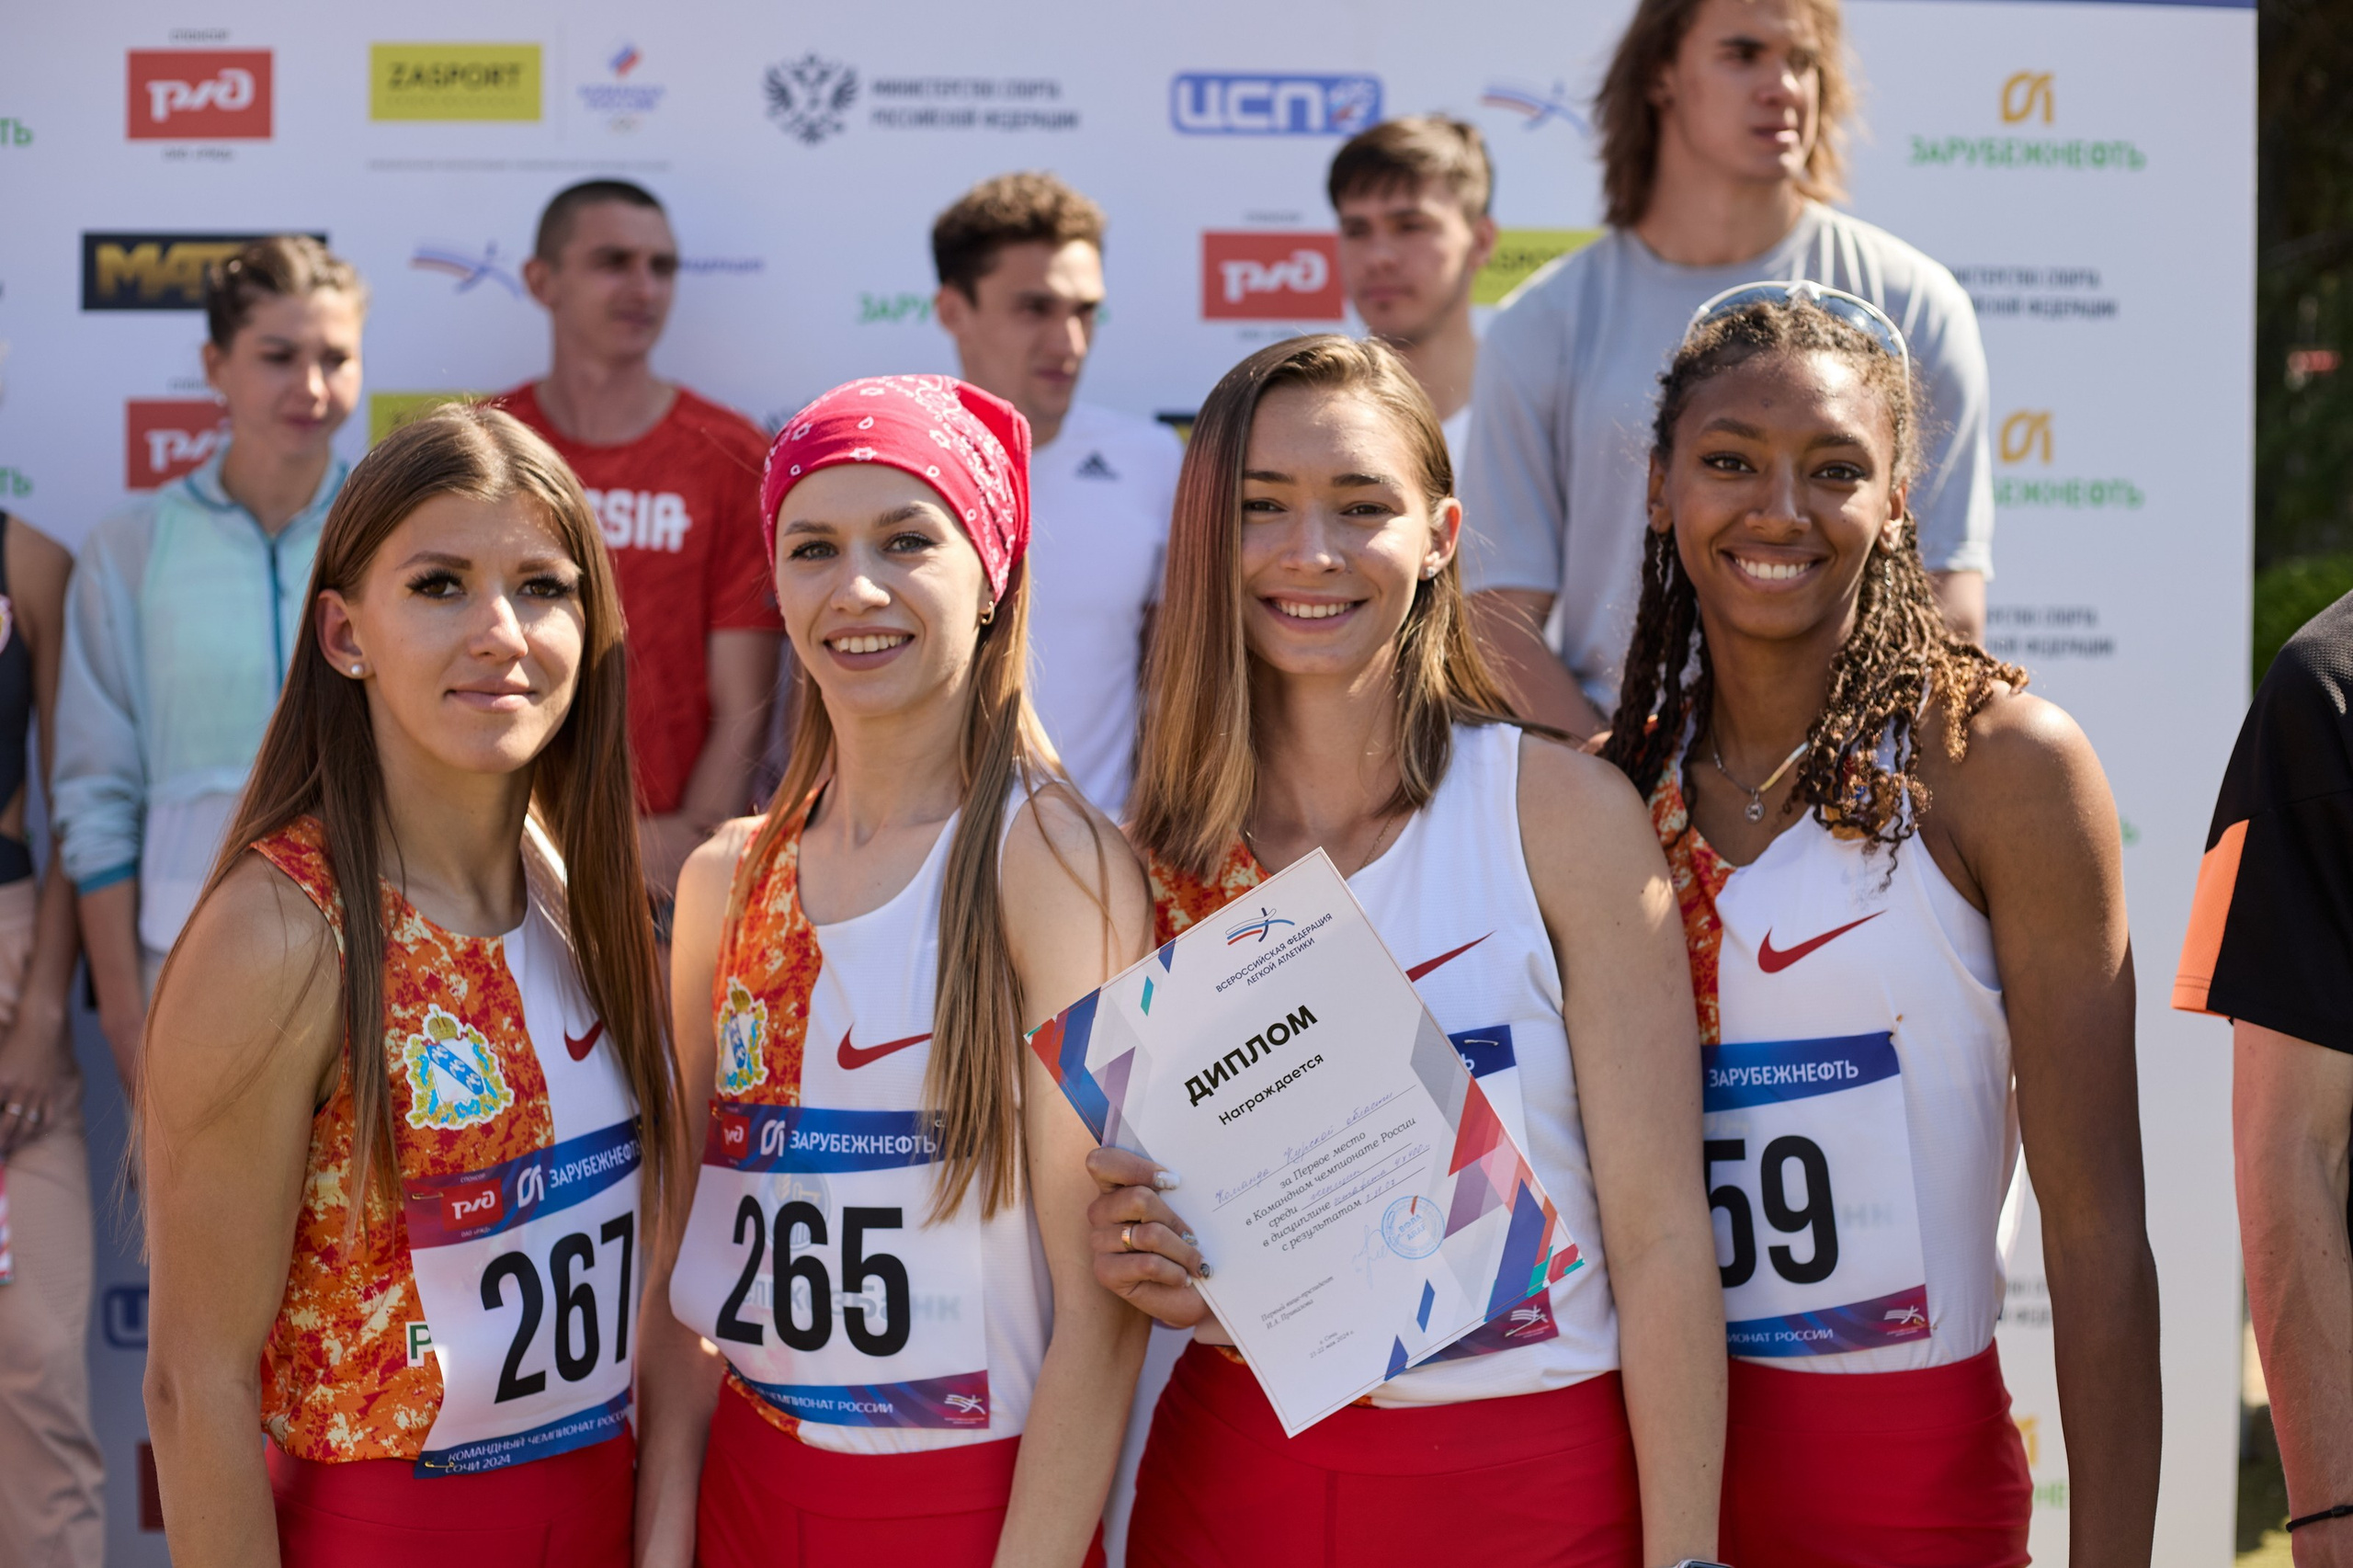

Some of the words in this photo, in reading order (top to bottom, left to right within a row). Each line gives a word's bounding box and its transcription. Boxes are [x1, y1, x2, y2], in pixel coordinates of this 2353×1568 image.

[388, 62, 522, 89] ZASPORT
[1178, 81, 1324, 130] ЦСП
[1909, 136, 2146, 170] ЗАРУБЕЖНЕФТЬ
[96, 242, 245, 301] МАТ
[1215, 942, 1287, 993] ВСЕРОССИЙСКАЯ
[1287, 913, 1333, 946] ФЕДЕРАЦИЯ
[1246, 961, 1277, 986] ЛЕГКОЙ
[1278, 937, 1315, 966] АТЛЕТИКИ
[1184, 1005, 1318, 1108] ДИПЛОМ
[1709, 1060, 1859, 1088] ЗАРУБЕЖНЕФТЬ
[1219, 1054, 1324, 1126] Награждается
[790, 1130, 937, 1155] ЗАРУБЕЖНЕФТЬ
[1279, 1177, 1292, 1189] за
[1293, 1153, 1331, 1181] Первое
[1333, 1131, 1366, 1158] место
[1245, 1218, 1252, 1226] в
[1253, 1180, 1313, 1221] Командном
[1313, 1140, 1380, 1183] чемпионате
[1380, 1118, 1416, 1142] России
[1263, 1239, 1269, 1247] в
[1270, 1201, 1331, 1243] дисциплине
[1268, 1206, 1298, 1228] среди
[1281, 1244, 1289, 1252] с
[1289, 1199, 1362, 1250] результатом
[1704, 1135, 1839, 1289] 59
[715, 1195, 911, 1358] 265
[480, 1210, 634, 1404] 267
[1727, 1332, 1770, 1345] ИОНАТ
[1775, 1328, 1835, 1342] РОССИИ
[837, 1401, 893, 1415] РОССИИ
[447, 1436, 526, 1463] КОМАНДНЫЙ
[528, 1419, 596, 1446] ЧЕМПИОНАТ
[483, 1454, 511, 1469] 2024
